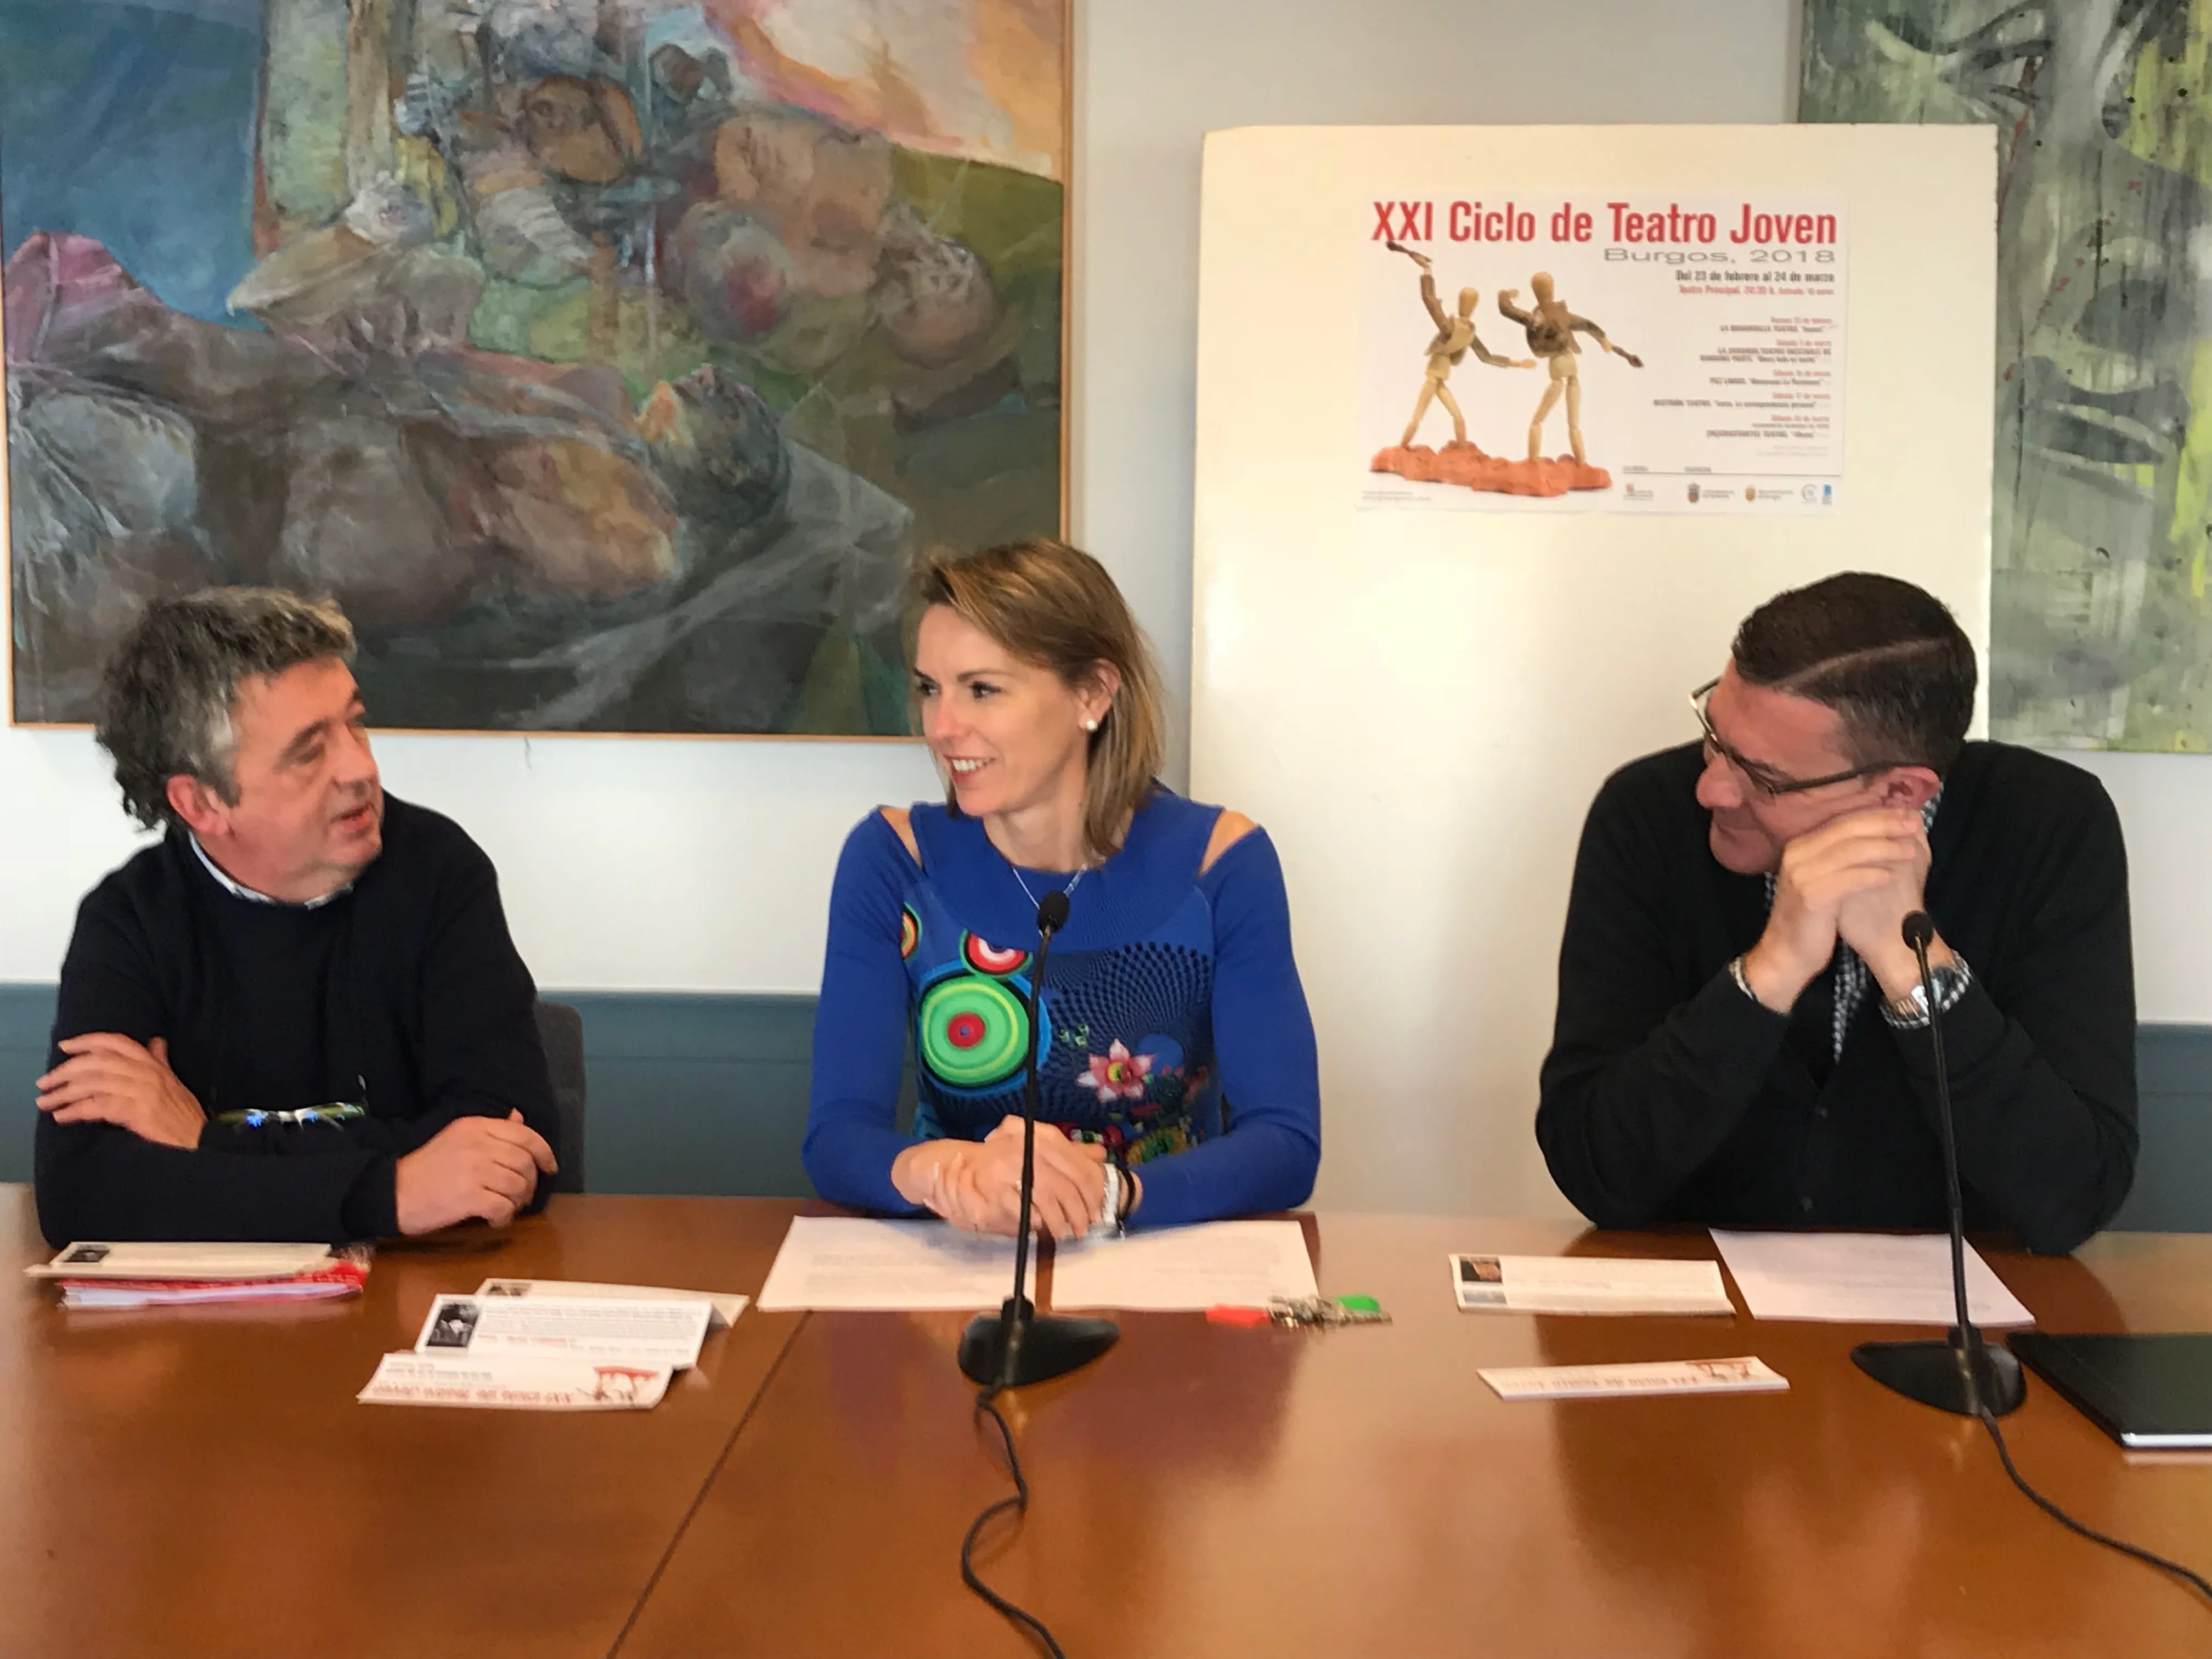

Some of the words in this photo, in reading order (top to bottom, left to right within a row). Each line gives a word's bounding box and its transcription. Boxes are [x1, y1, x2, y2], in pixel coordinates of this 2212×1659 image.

[1371, 201, 1433, 241] XXI
[1449, 201, 1535, 241] Ciclo
[1551, 203, 1592, 242] de
[1608, 202, 1717, 244] Teatro
[1730, 204, 1836, 244] Joven
[1604, 247, 1736, 265] Burgos,
[1750, 249, 1836, 263] 2018
[1675, 269, 1692, 281] Del
[1694, 270, 1707, 281] 23
[1709, 270, 1722, 281] de
[1724, 270, 1760, 282] febrero
[1762, 271, 1772, 282] al
[1774, 271, 1787, 282] 24
[1790, 272, 1802, 282] de
[1805, 273, 1835, 283] marzo
